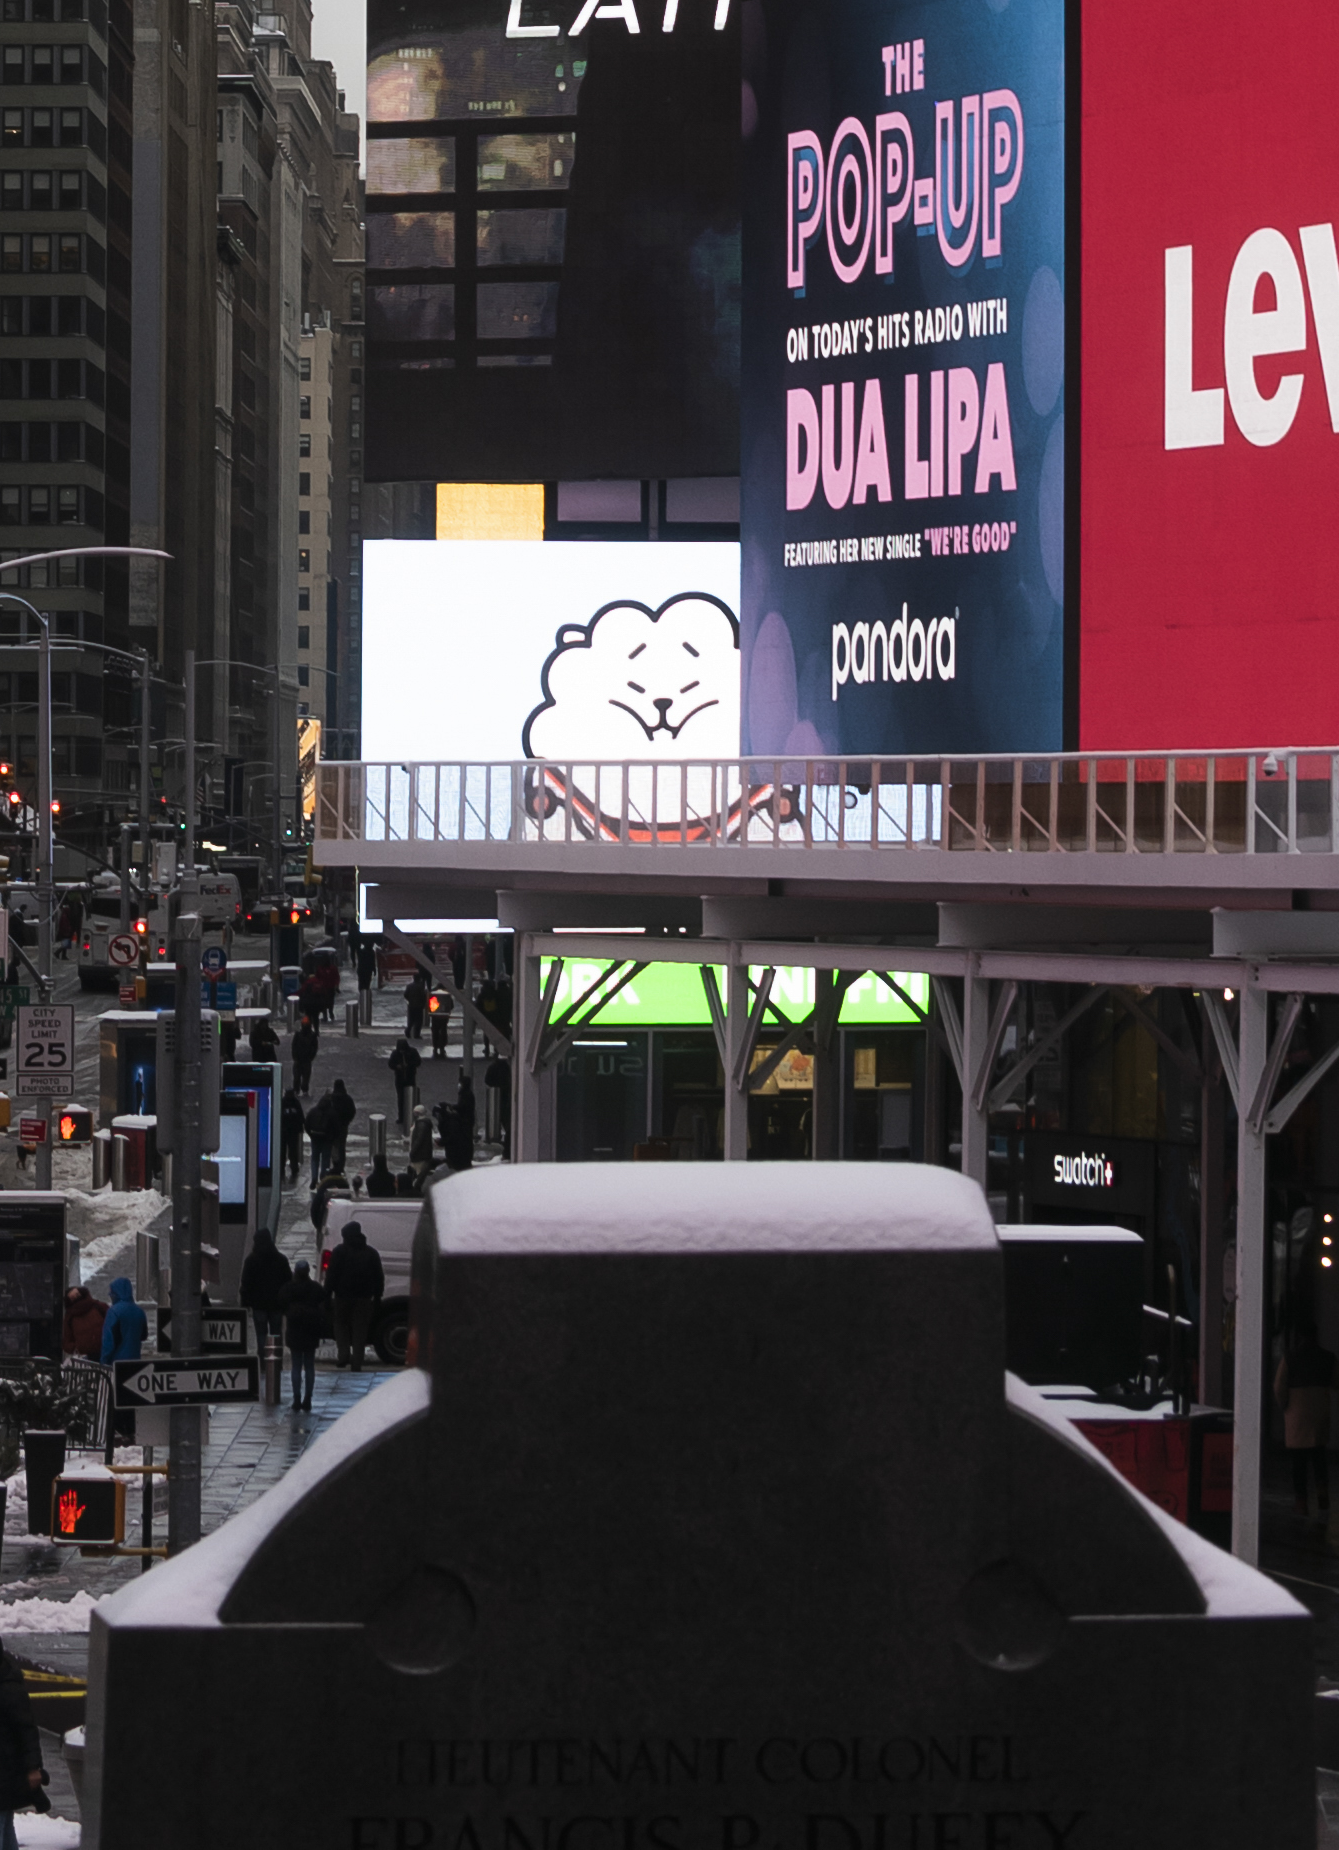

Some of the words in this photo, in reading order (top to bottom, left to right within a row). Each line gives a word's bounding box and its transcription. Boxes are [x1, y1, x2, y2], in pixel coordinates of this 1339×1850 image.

[882, 38, 925, 97] THE
[786, 87, 1026, 290] POP-UP
[786, 326, 810, 363] ON
[812, 313, 874, 361] TODAY'S
[876, 309, 911, 352] HITS
[913, 304, 965, 347] RADIO
[966, 297, 1008, 340] WITH
[785, 376, 893, 511] DUA
[905, 361, 1017, 501] LIPA
[784, 542, 837, 567] FEATURING
[839, 540, 860, 564] HER
[861, 537, 886, 561] NEW
[886, 533, 922, 560] SINGLE
[923, 526, 970, 557] "WE'RE
[972, 521, 1017, 553] GOOD"
[831, 601, 955, 700] pandora
[199, 884, 232, 896] FedEx
[27, 1019, 62, 1029] SPEED
[32, 1008, 56, 1019] CITY
[31, 1029, 58, 1040] LIMIT
[24, 1042, 67, 1069] 25
[21, 1084, 69, 1095] ENFORCED
[29, 1077, 61, 1087] PHOTO
[1053, 1152, 1104, 1186] swatch
[208, 1322, 236, 1341] WAY
[137, 1373, 178, 1392] ONE
[197, 1371, 240, 1391] WAY
[395, 1736, 736, 1788] LIEUTENANT
[754, 1734, 1029, 1787] COLONEL
